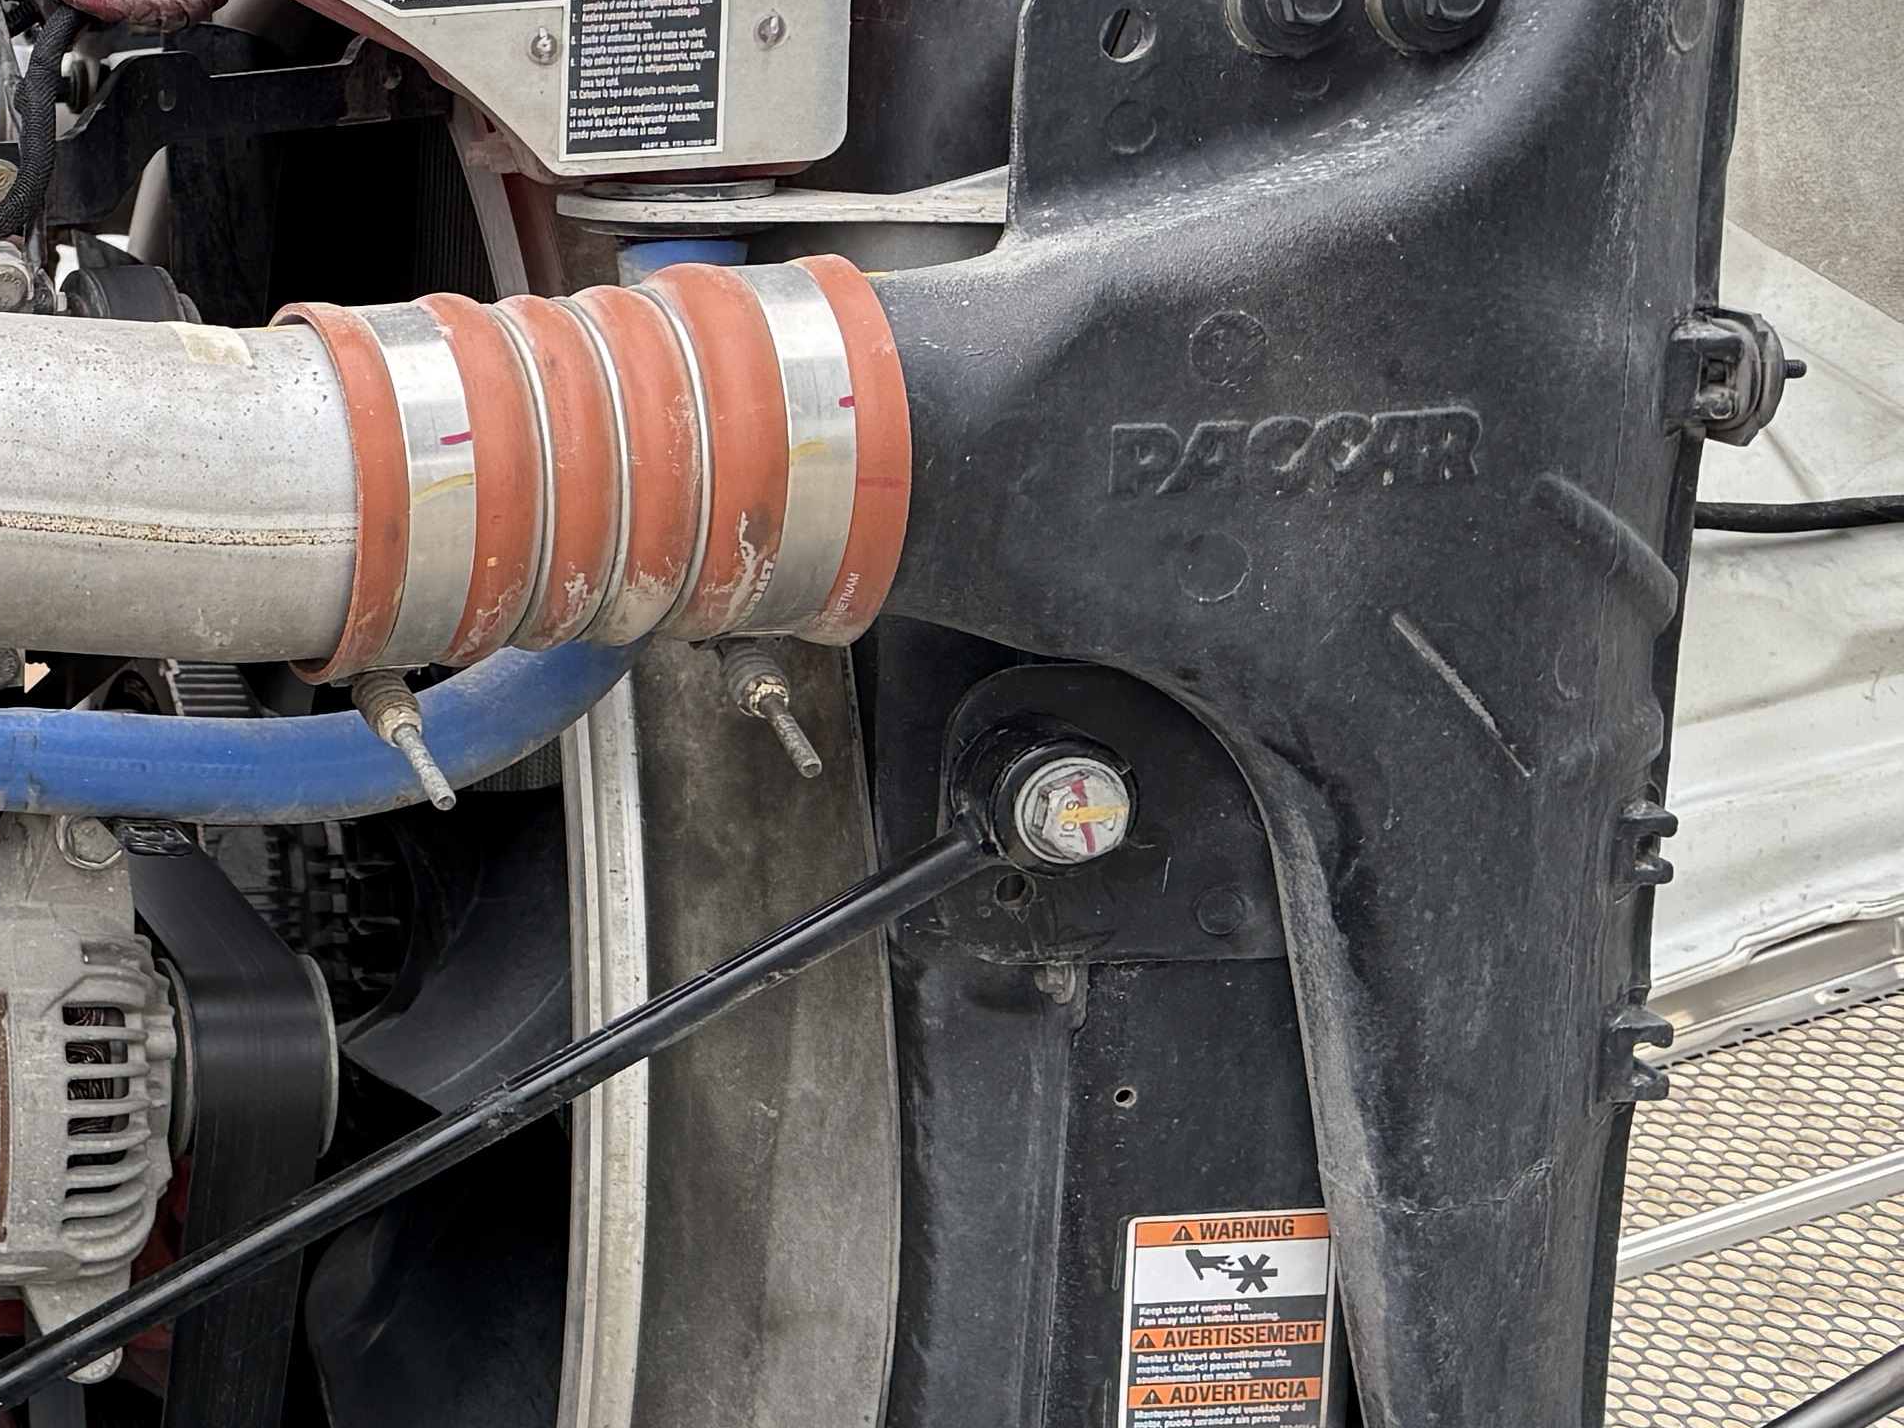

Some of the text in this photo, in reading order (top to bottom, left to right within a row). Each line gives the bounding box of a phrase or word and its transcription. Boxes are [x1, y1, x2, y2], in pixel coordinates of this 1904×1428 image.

[1107, 403, 1484, 498] PACCAR
[1199, 1219, 1294, 1240] WARNING
[1163, 1323, 1322, 1348] AVERTISSEMENT
[1169, 1381, 1308, 1404] ADVERTENCIA
